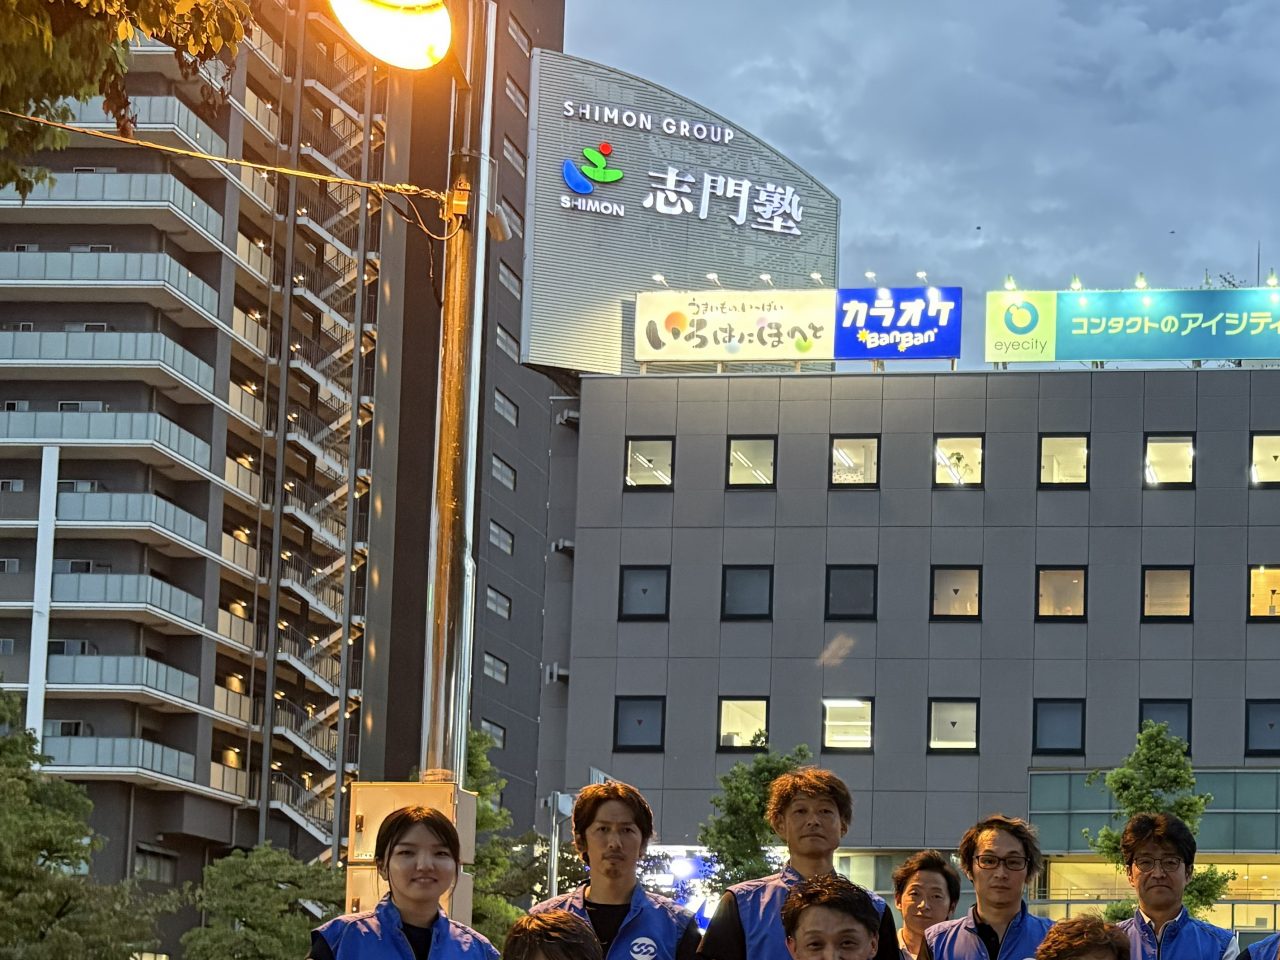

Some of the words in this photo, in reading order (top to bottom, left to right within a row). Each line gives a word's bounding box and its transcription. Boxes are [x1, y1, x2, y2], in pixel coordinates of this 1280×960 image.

[562, 101, 652, 131] SHIMON
[662, 117, 735, 145] GROUP
[560, 195, 625, 217] SHIMON
[642, 166, 805, 236] 志門塾
[841, 298, 955, 328] カラオケ
[645, 318, 825, 351] いろはにほへと
[994, 339, 1047, 354] eyecity
